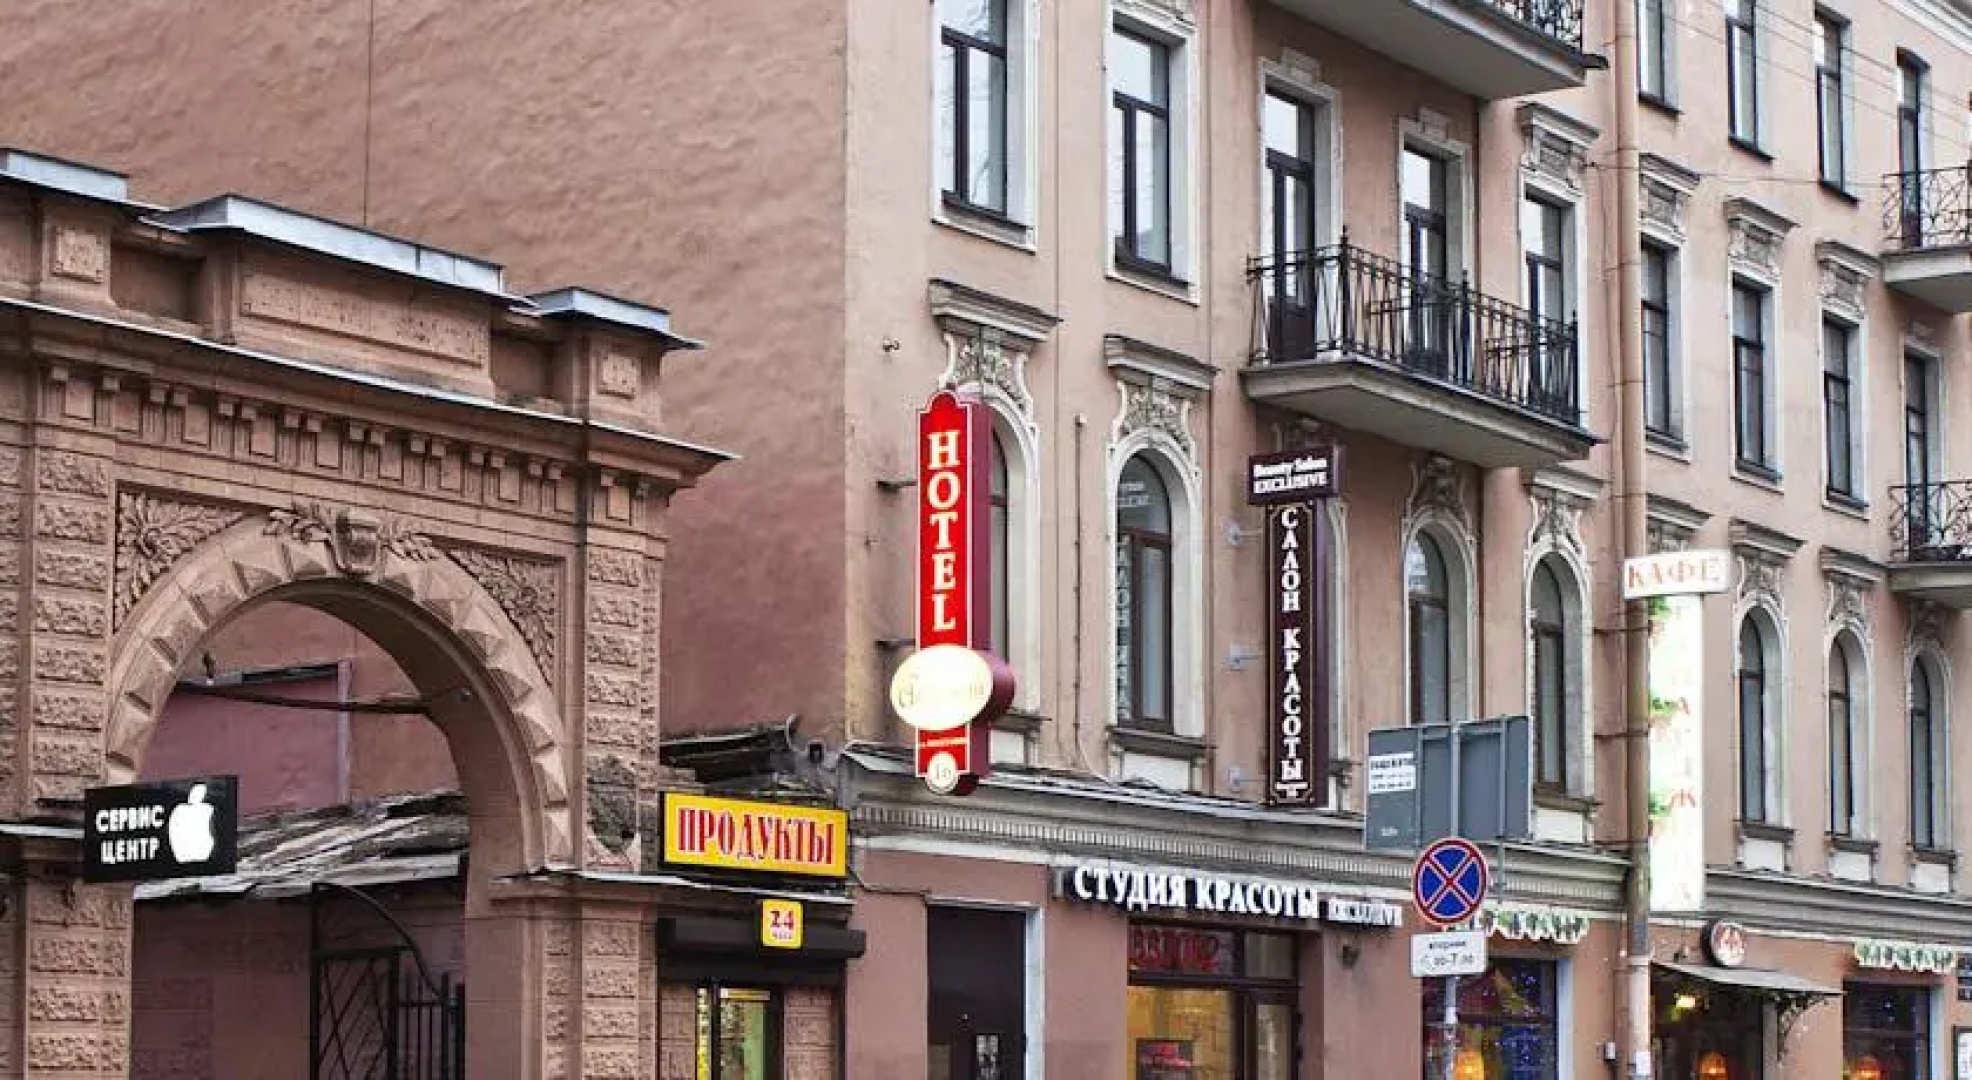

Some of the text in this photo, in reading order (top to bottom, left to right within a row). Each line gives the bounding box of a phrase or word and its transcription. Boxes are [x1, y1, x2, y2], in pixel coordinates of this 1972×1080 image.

[926, 428, 961, 632] HOTEL
[1280, 507, 1302, 612] САЛОН
[1627, 556, 1721, 590] КАФЕ
[1282, 627, 1304, 780] КРАСОТЫ
[95, 805, 165, 833] СЕРВИС
[678, 808, 836, 865] ПРОДУКТЫ
[100, 836, 161, 865] ЦЕНТР
[1073, 865, 1320, 919] СТУДИЯ КРАСОТЫ
[769, 910, 795, 931] 24
